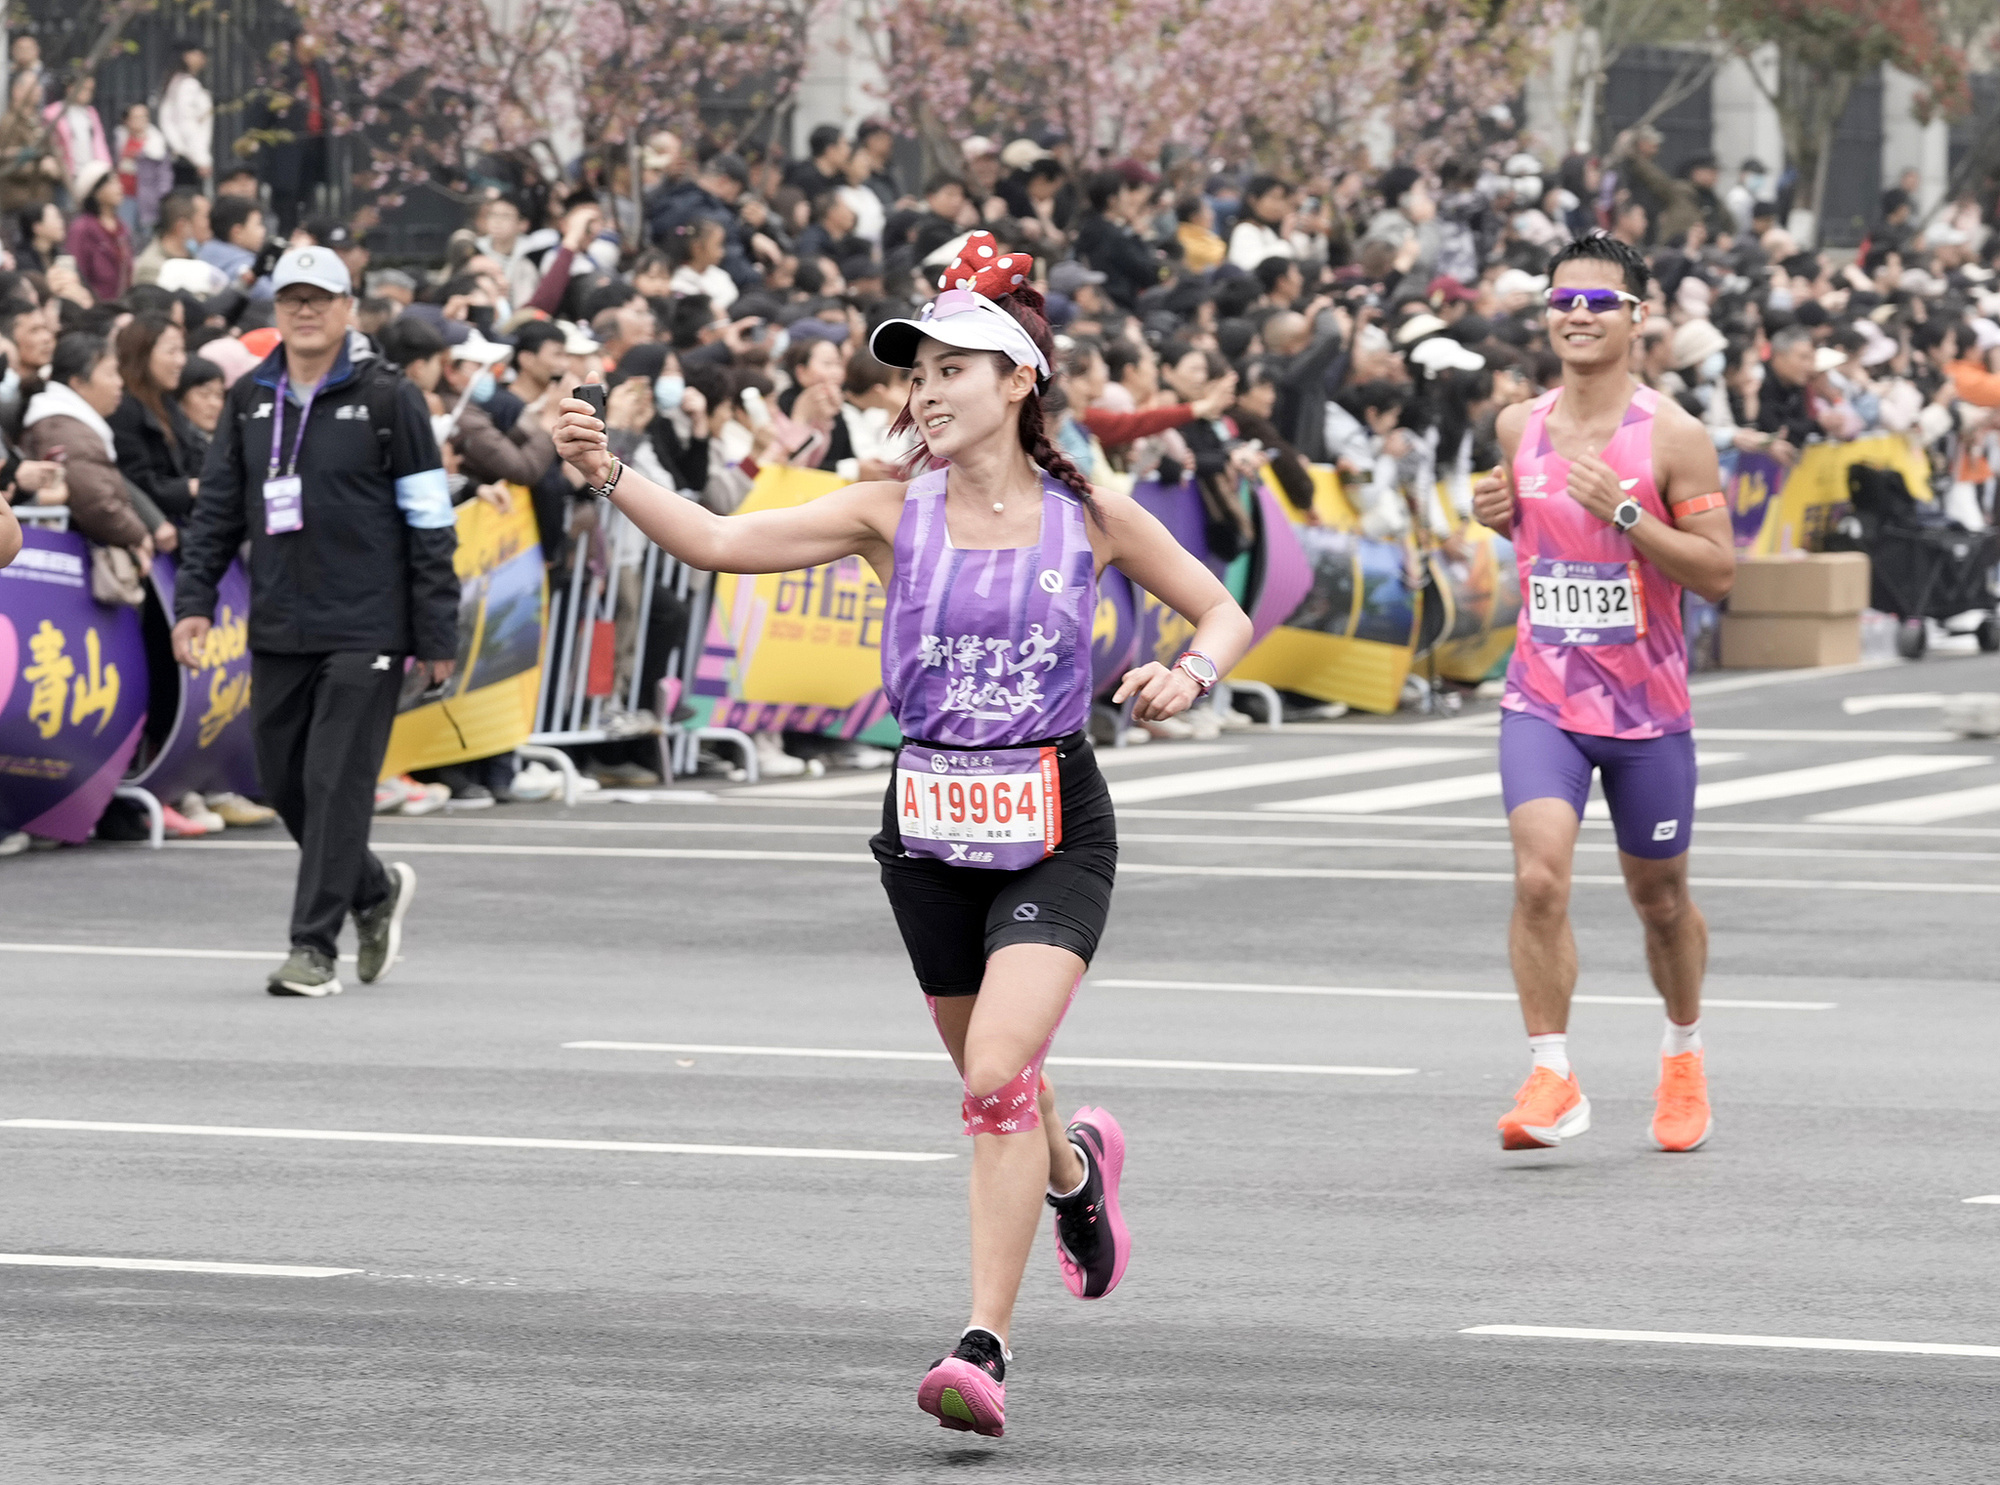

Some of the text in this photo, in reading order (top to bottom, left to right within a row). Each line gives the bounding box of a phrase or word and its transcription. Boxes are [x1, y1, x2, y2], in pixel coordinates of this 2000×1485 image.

[1533, 582, 1629, 614] B10132
[917, 634, 1013, 677] 别等了
[23, 619, 120, 740] 青山
